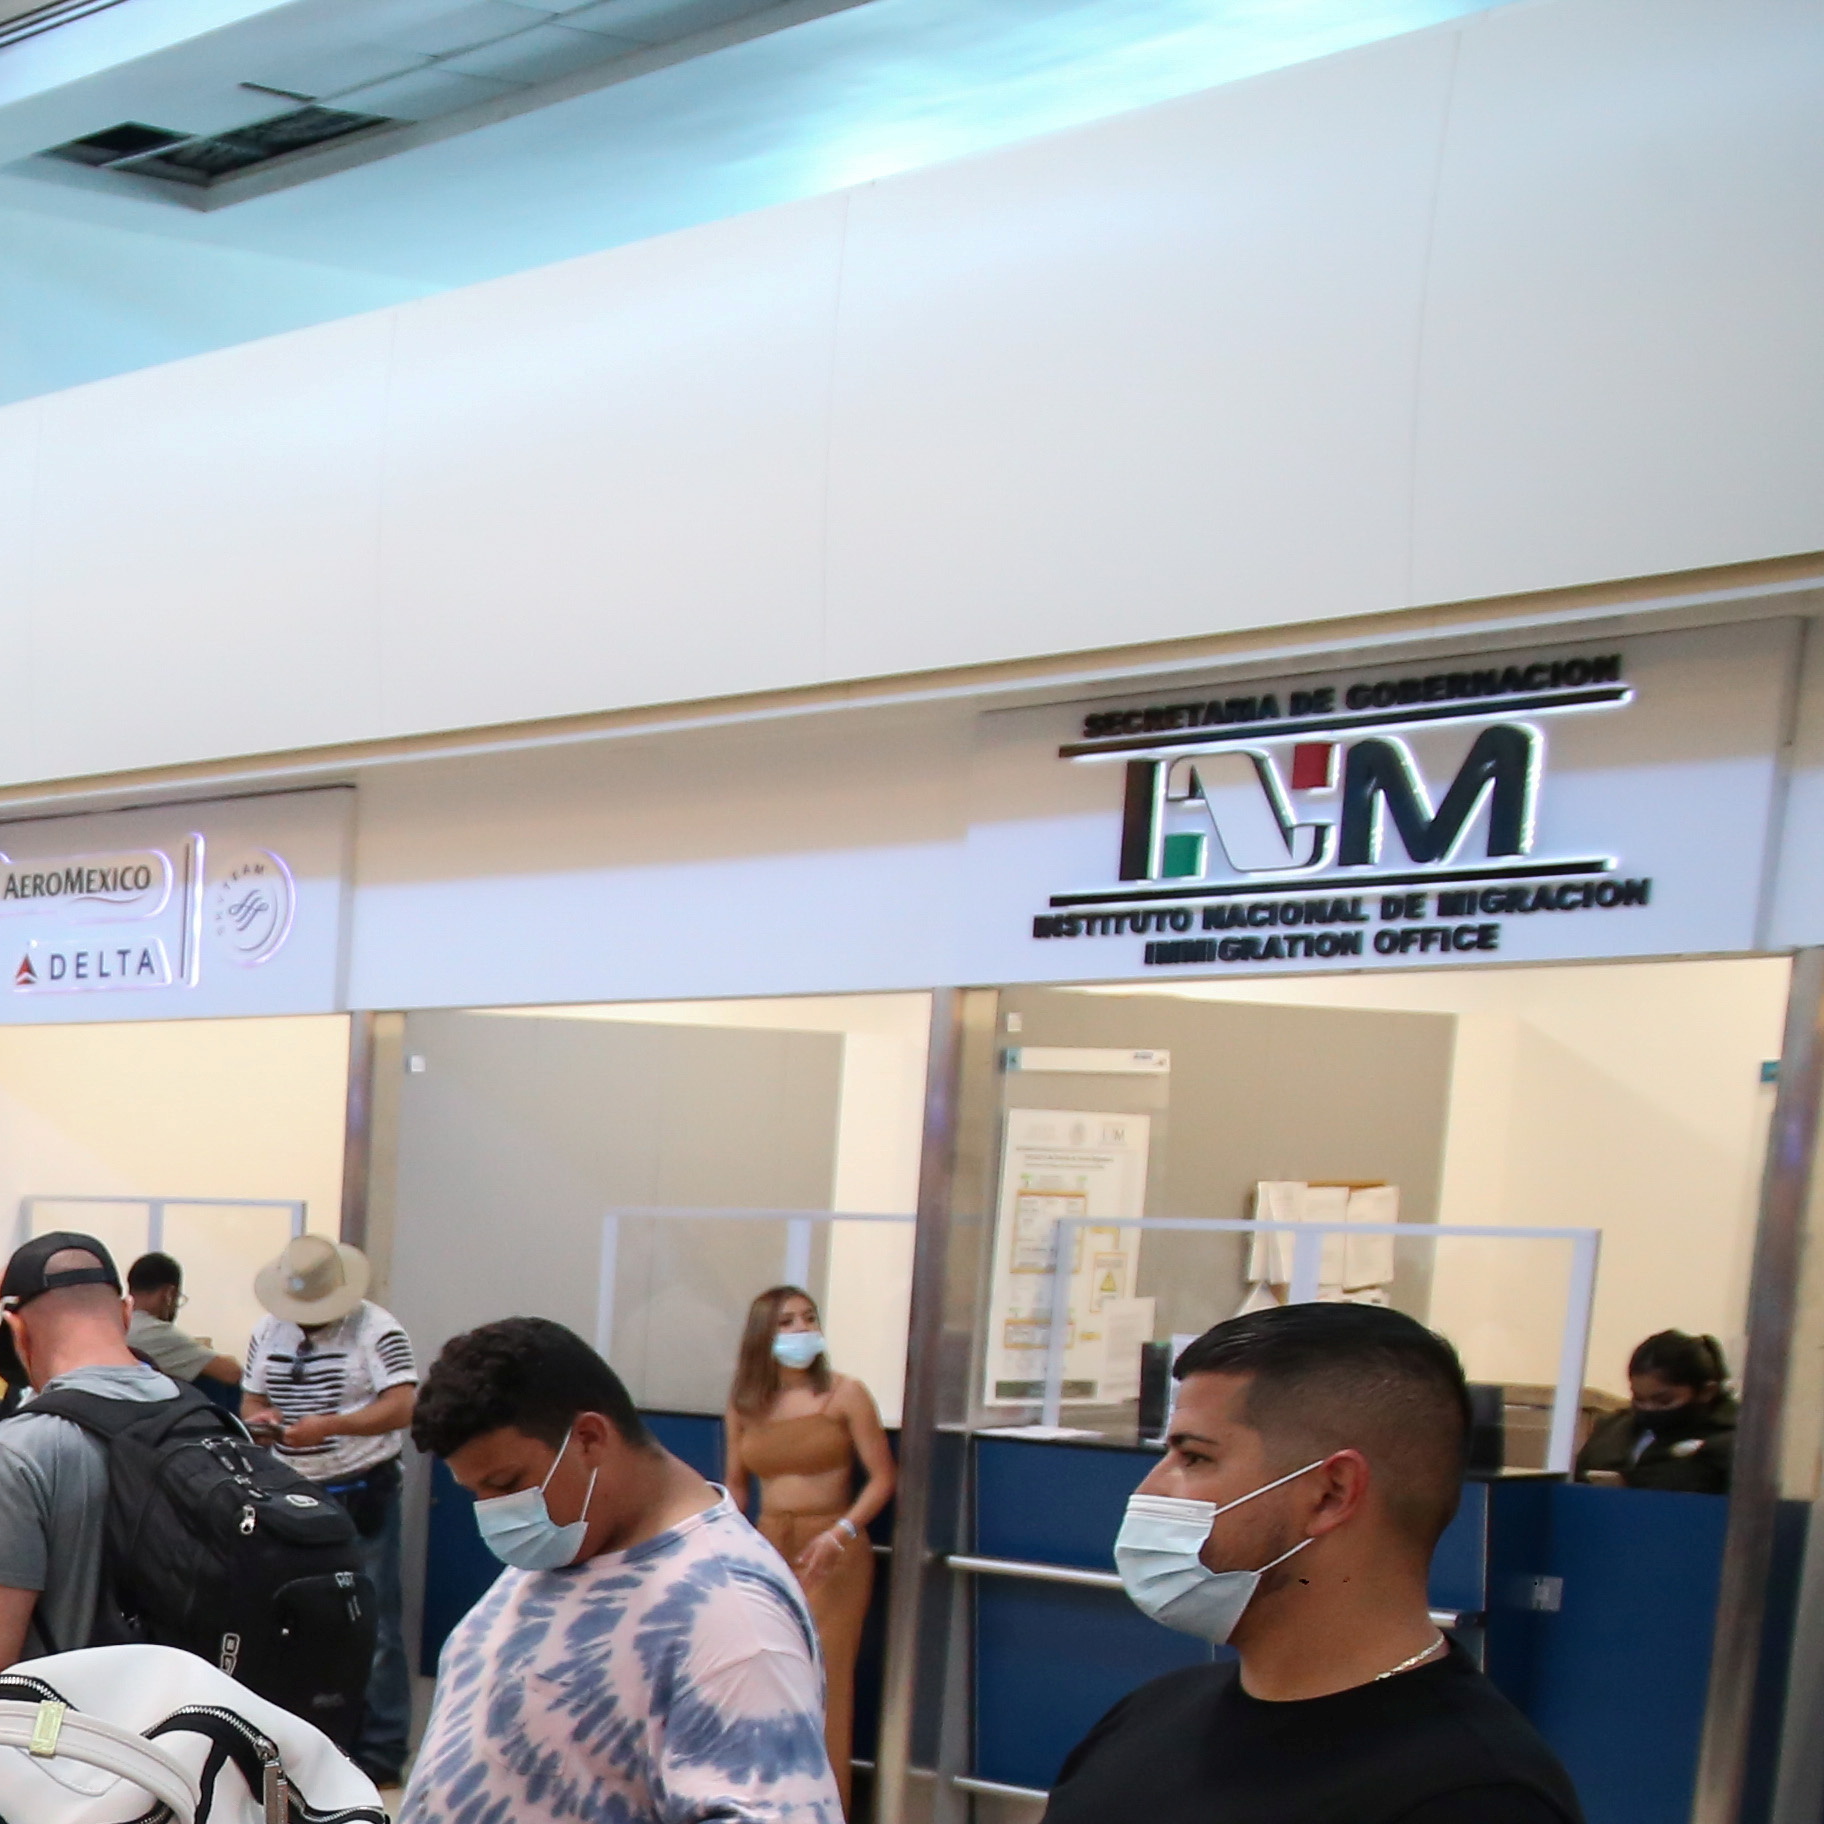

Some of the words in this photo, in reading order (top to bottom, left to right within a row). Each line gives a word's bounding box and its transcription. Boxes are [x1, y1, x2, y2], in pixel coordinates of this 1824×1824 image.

[1083, 693, 1281, 738] SECRETARIA
[1289, 686, 1336, 717] DE
[1345, 653, 1623, 711] GOBERNACION
[1033, 907, 1194, 939] INSTITUTO
[1202, 897, 1370, 931] NACIONAL
[1380, 892, 1428, 921] DE
[1437, 876, 1653, 917] MIGRACION
[49, 947, 156, 981] DELTA
[1144, 930, 1365, 965] IMMIGRATION
[1373, 922, 1501, 955] OFFICE
